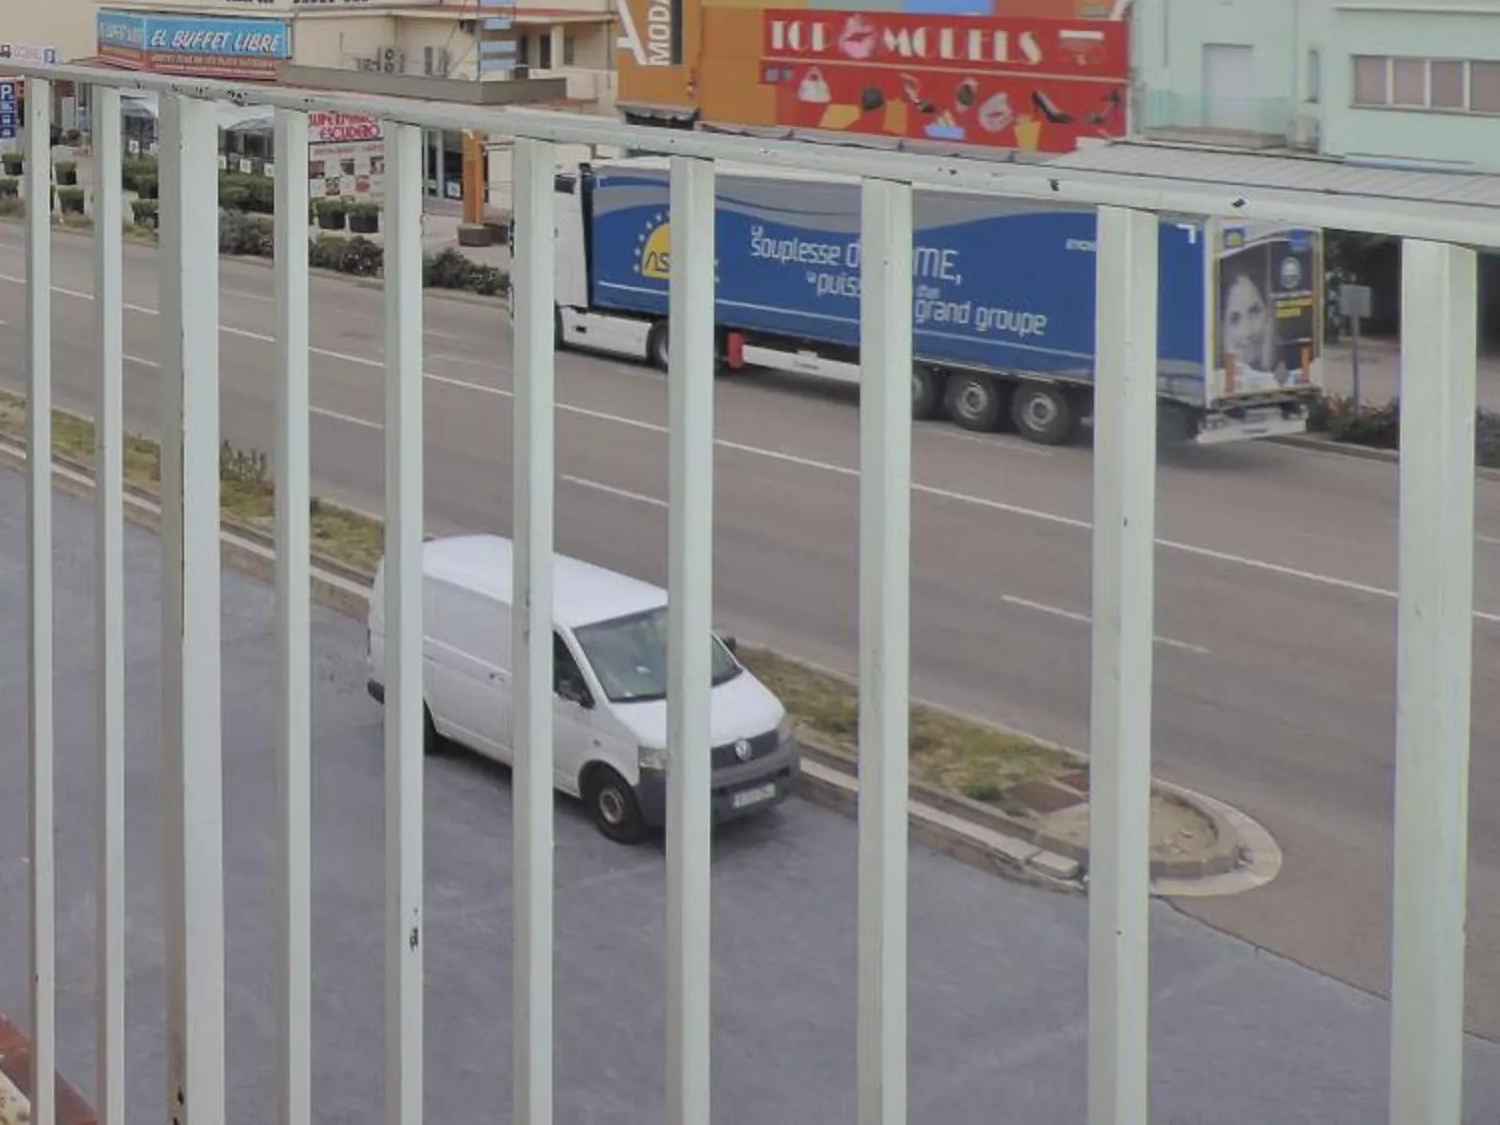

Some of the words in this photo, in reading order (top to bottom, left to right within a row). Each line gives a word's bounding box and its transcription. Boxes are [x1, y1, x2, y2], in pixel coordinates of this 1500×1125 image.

[151, 29, 168, 47] EL
[172, 29, 232, 51] BUFFET
[234, 31, 283, 53] LIBRE
[769, 19, 830, 52] TOP
[883, 25, 1044, 65] MODELS
[644, 249, 668, 274] AS
[913, 246, 963, 286] ME,
[914, 297, 971, 324] grand
[976, 305, 1048, 337] groupe
